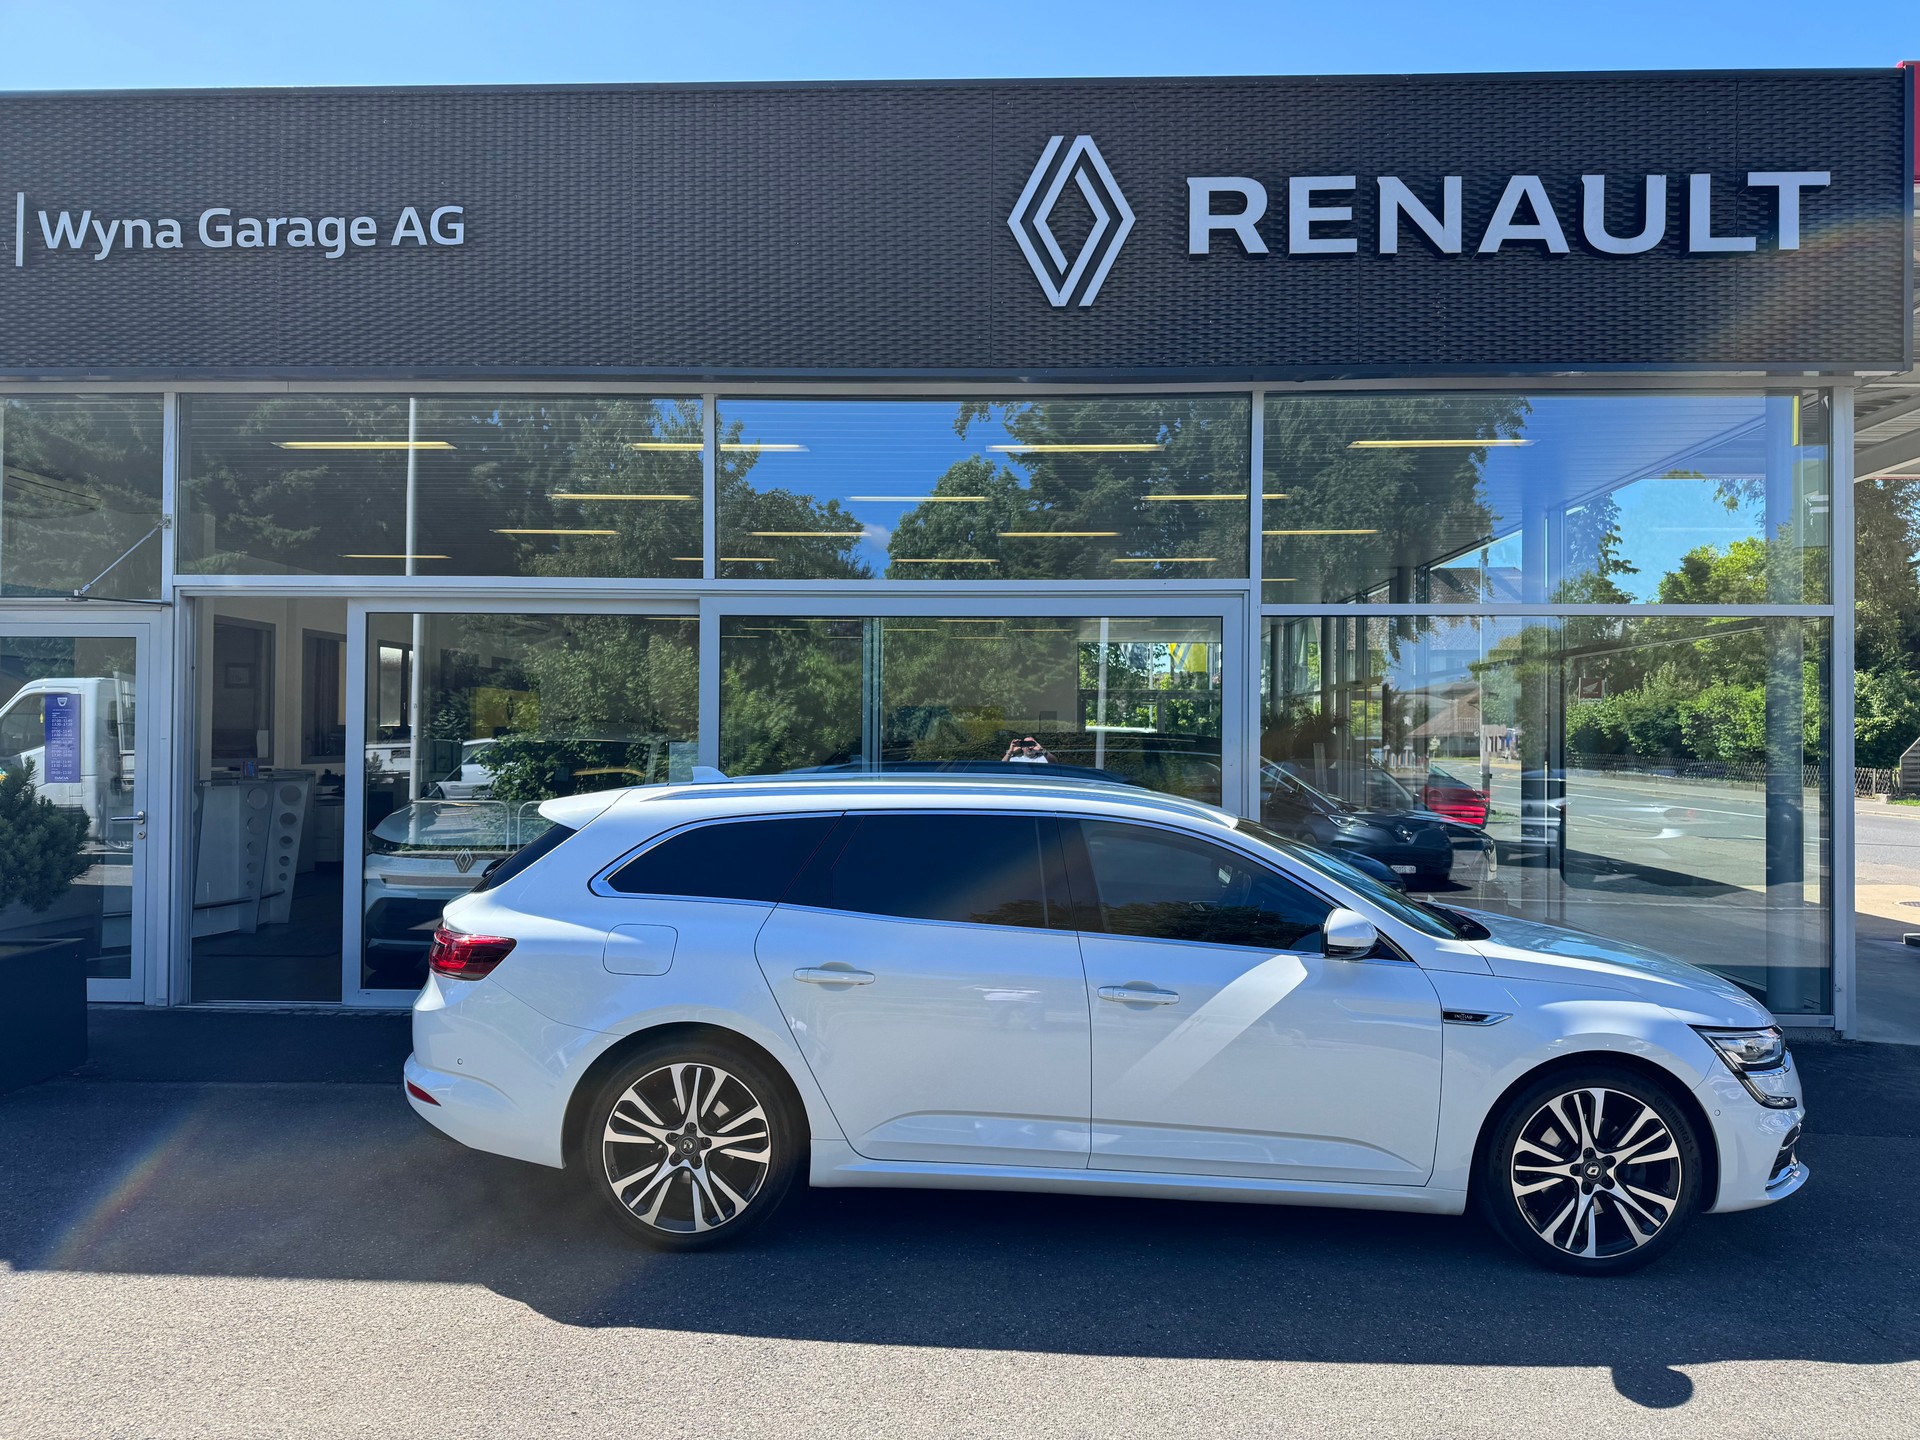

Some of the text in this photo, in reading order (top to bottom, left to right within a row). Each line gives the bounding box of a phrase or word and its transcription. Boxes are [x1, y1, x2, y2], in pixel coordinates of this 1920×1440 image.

[38, 205, 466, 260] Wyna Garage AG
[1187, 171, 1831, 255] RENAULT
